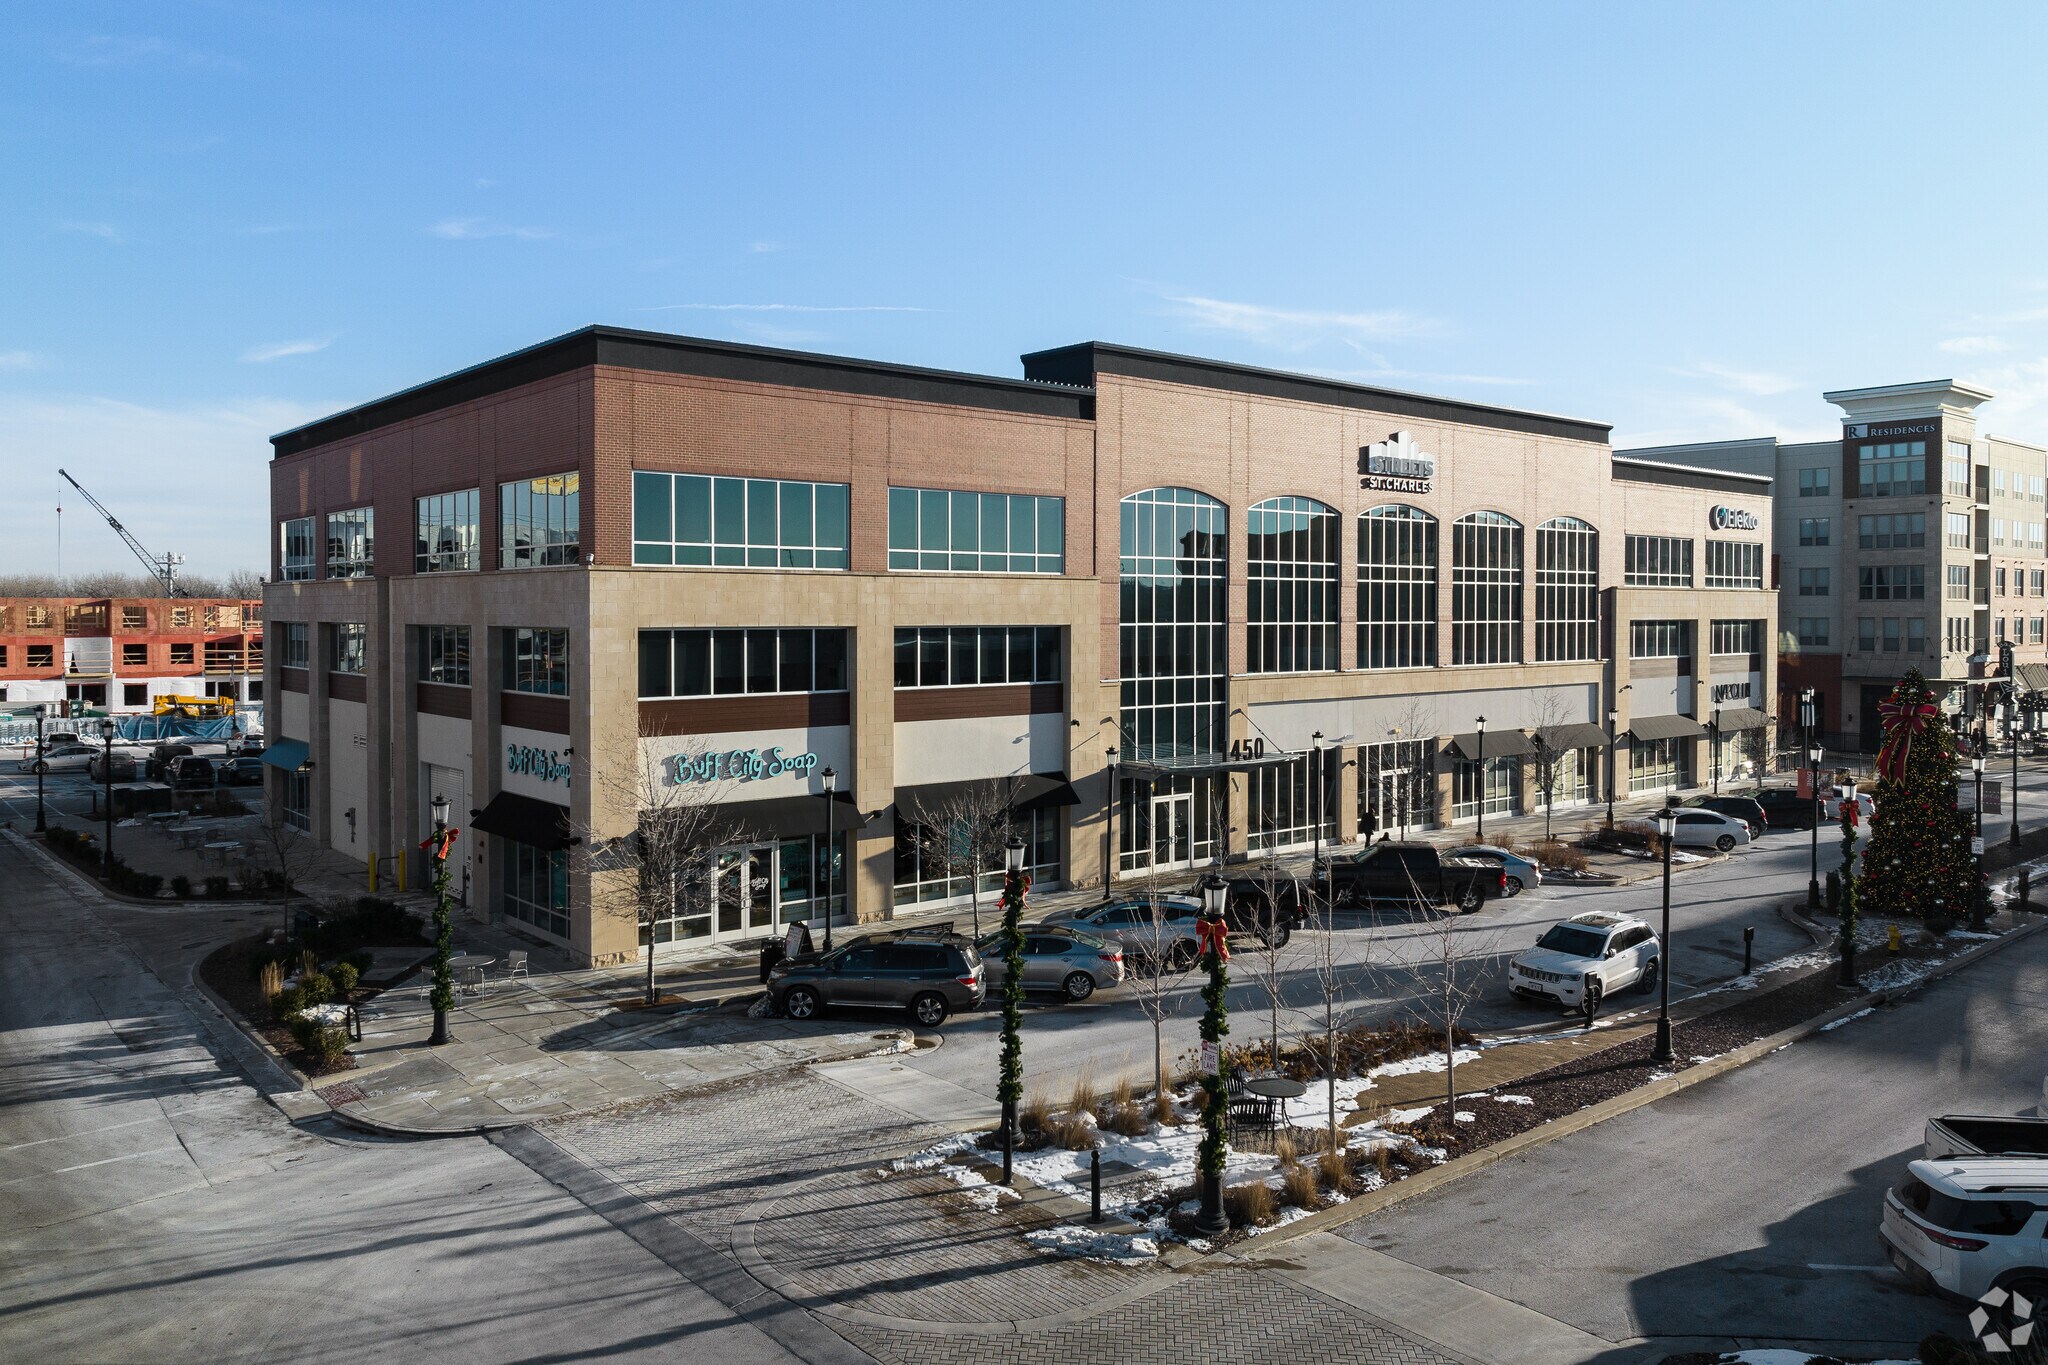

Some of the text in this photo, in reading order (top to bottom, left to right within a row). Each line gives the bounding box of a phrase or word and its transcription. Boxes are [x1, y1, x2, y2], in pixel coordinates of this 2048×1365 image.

[1870, 424, 1936, 437] RESIDENCES
[1374, 456, 1434, 477] STREETS
[507, 744, 571, 788] Buff City Soap
[674, 746, 818, 784] Buff City Soap
